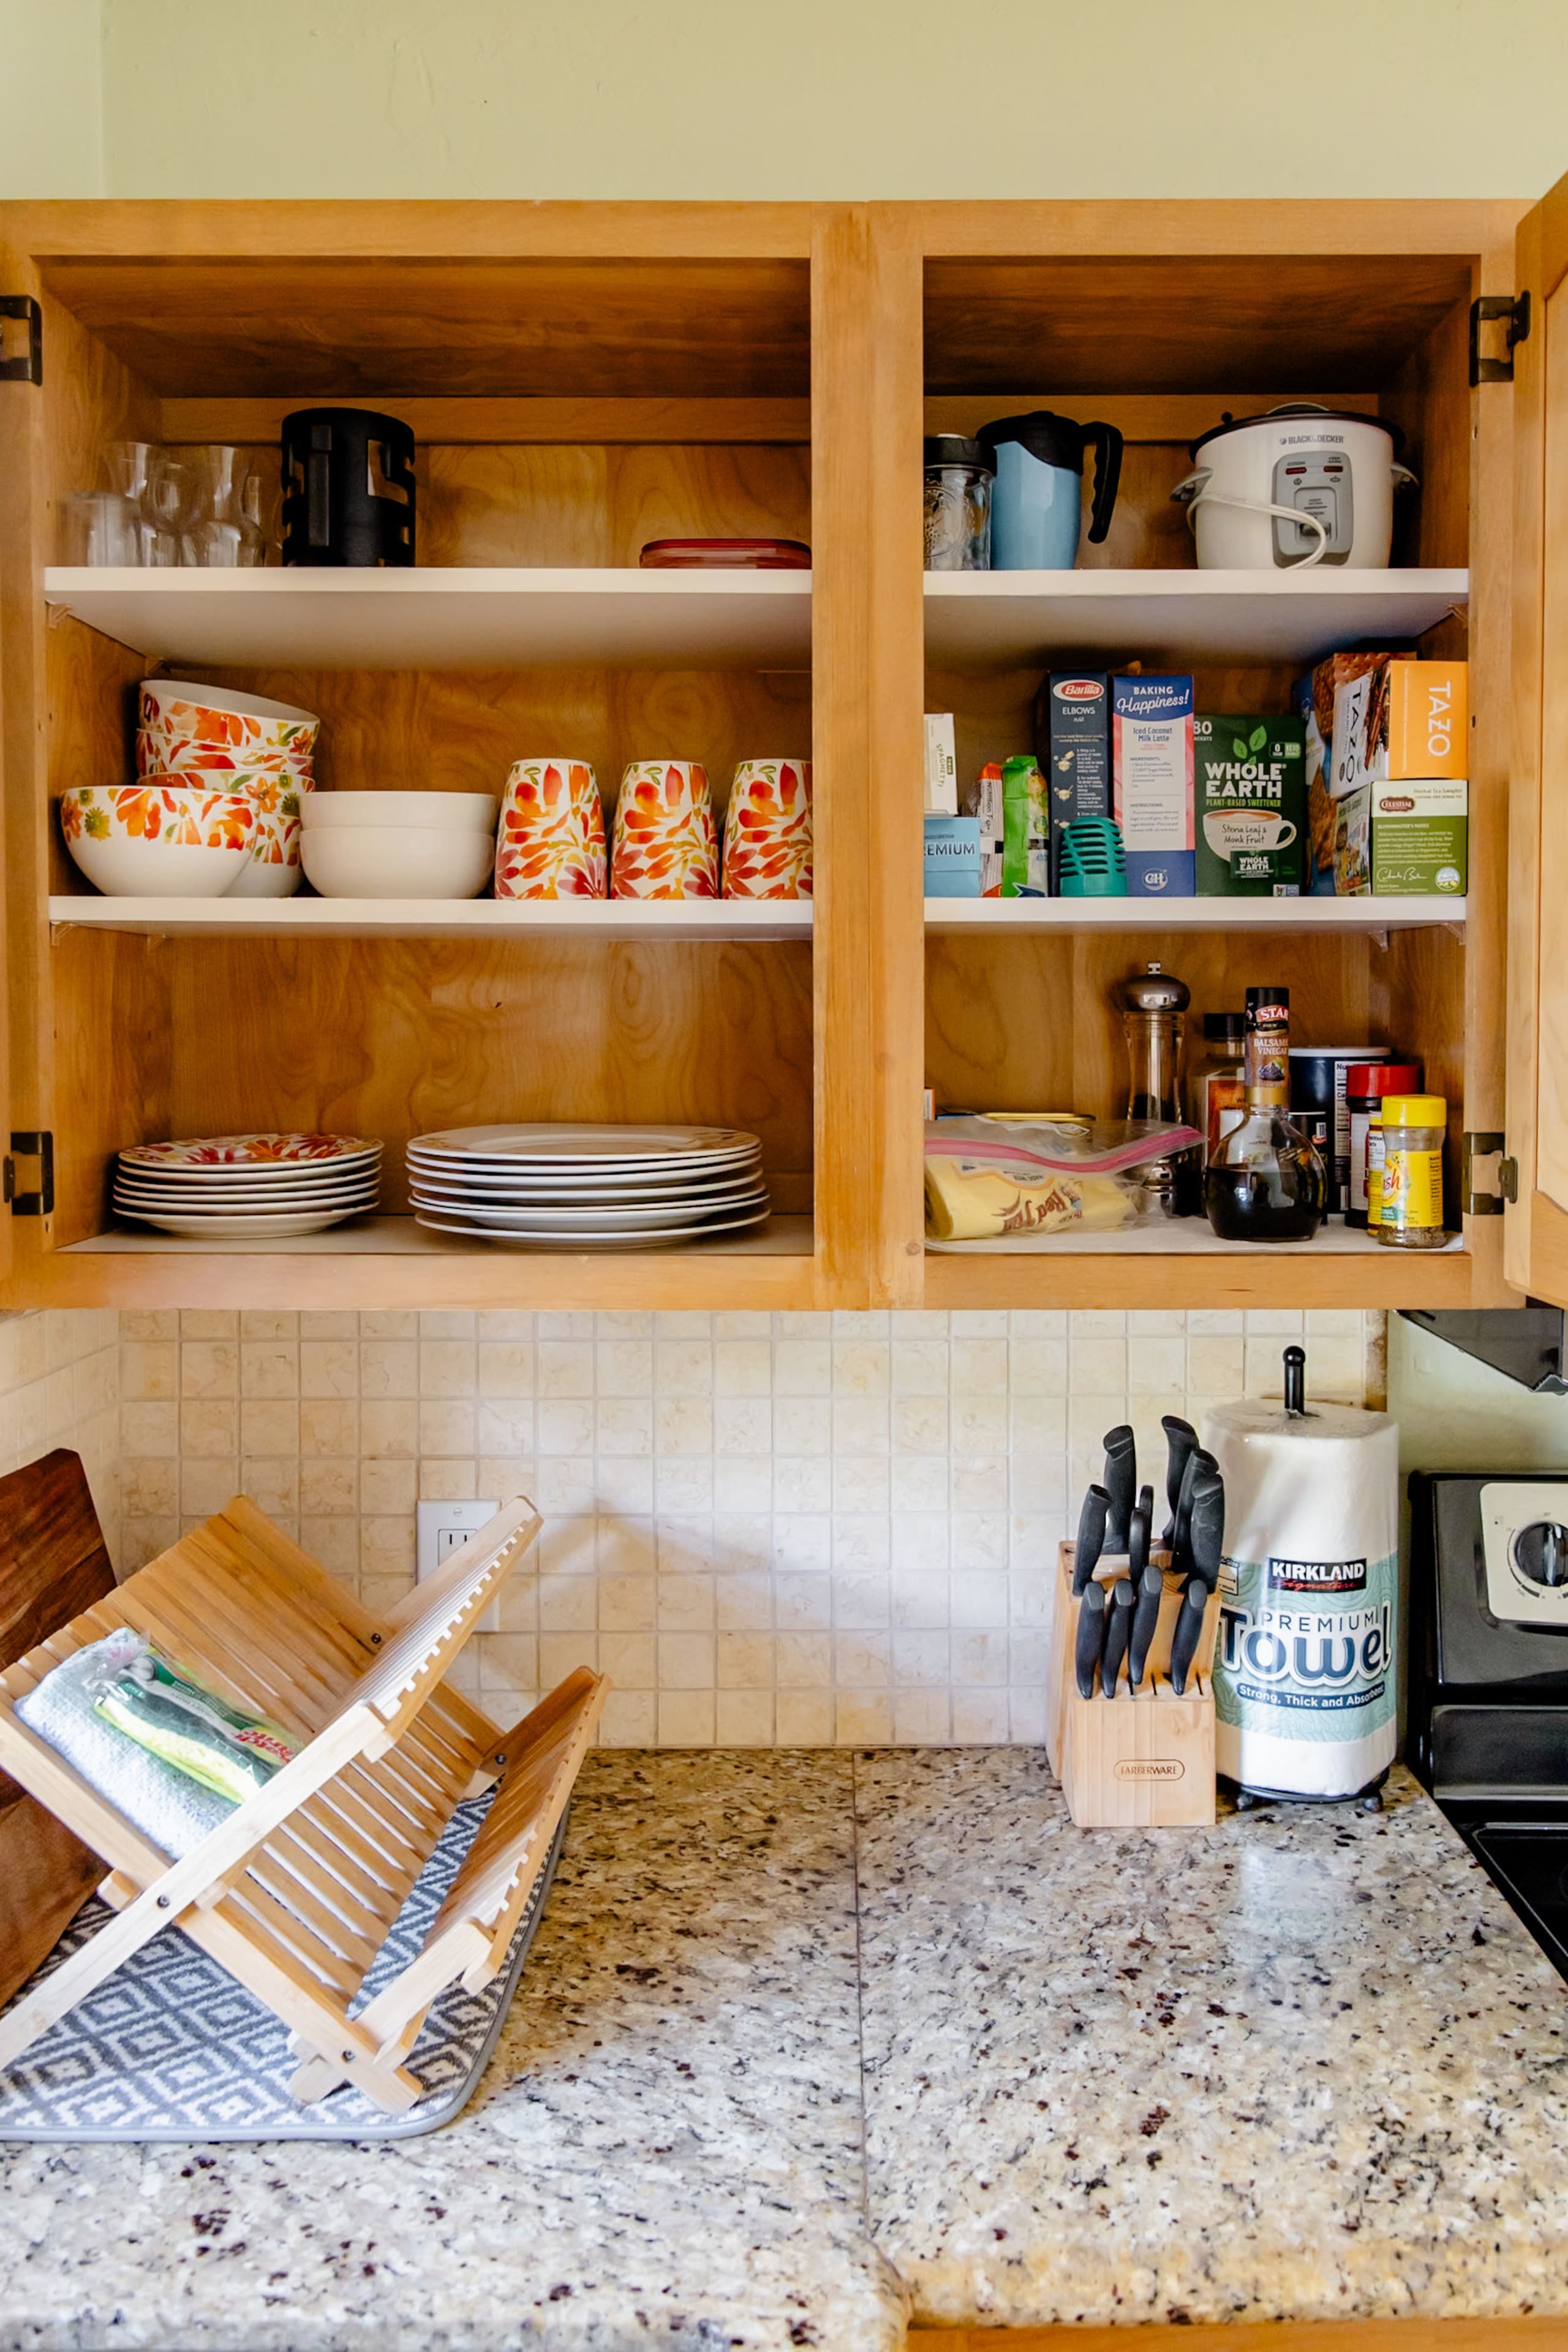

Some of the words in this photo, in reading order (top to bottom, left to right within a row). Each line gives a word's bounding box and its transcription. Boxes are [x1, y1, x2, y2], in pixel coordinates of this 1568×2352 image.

[1066, 685, 1100, 694] Barilla
[1134, 686, 1174, 695] BAKING
[1062, 706, 1095, 715] ELBOWS
[1117, 689, 1189, 715] Happiness!
[1428, 681, 1451, 757] TAZO
[1346, 683, 1362, 783] TAZO
[935, 743, 946, 787] SPAGHETTI
[1205, 762, 1282, 781] WHOLE
[1206, 781, 1282, 798] EARTH
[1222, 824, 1244, 833] Stevia
[1246, 824, 1261, 836] Leaf
[1224, 835, 1244, 844] Monk
[1246, 834, 1264, 844] Fruit
[924, 844, 974, 855] EMIUM
[1272, 1562, 1365, 1581] KIRKLAND
[1263, 1611, 1374, 1632] PREMIUM
[1219, 1605, 1389, 1679] Towel
[1239, 1685, 1281, 1704] Strong,
[1285, 1695, 1317, 1706] Thick
[1346, 1685, 1384, 1706] Absorbent
